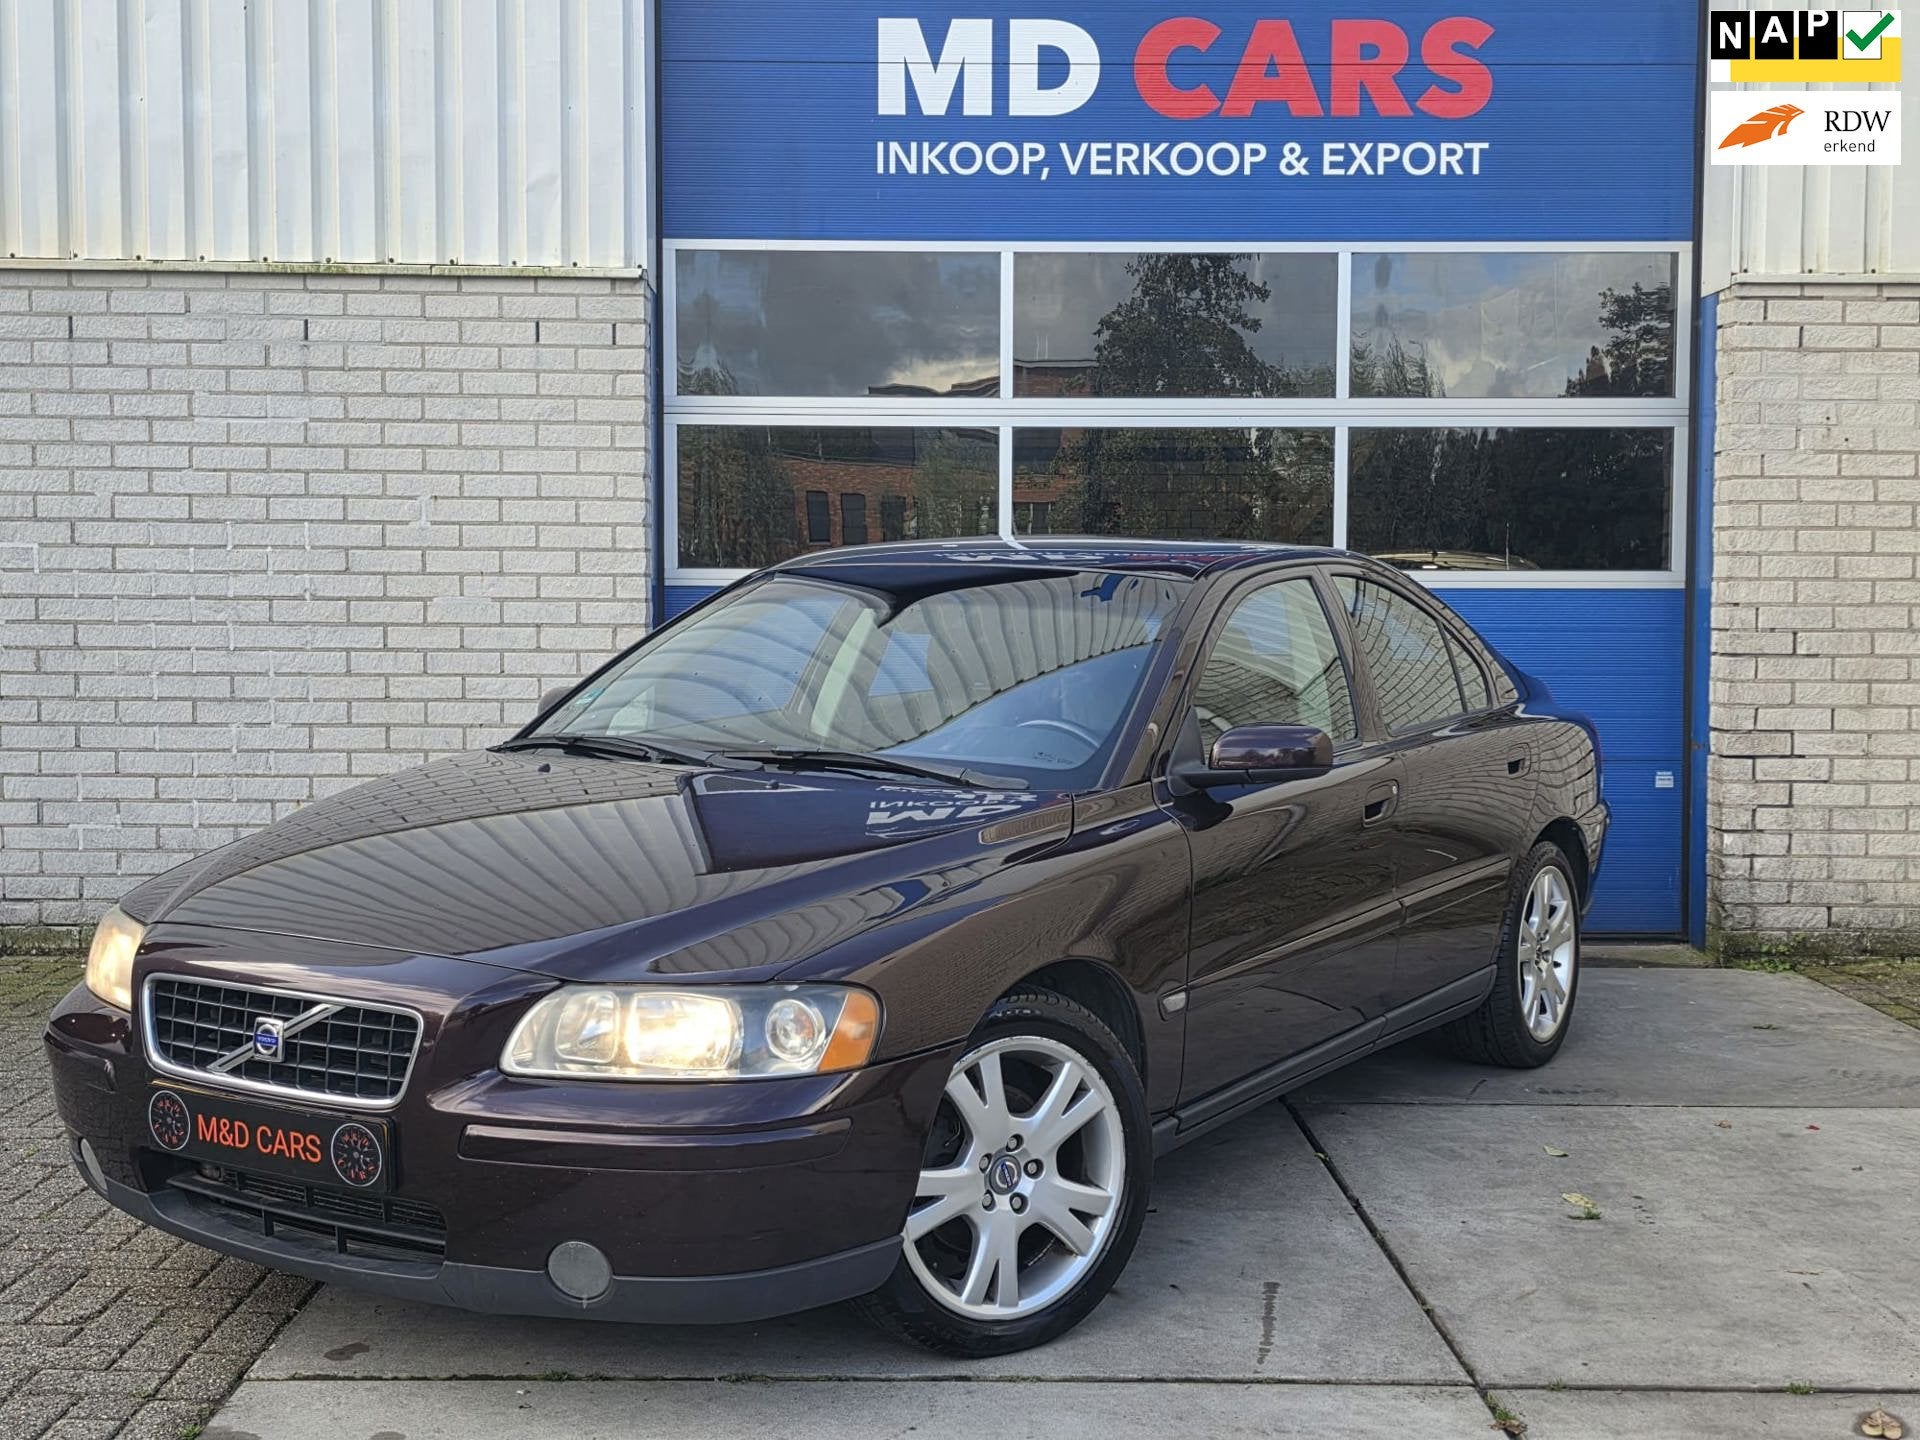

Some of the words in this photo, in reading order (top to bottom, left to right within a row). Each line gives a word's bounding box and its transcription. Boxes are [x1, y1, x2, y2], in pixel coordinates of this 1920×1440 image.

[877, 17, 1101, 117] MD
[1133, 15, 1496, 120] CARS
[876, 140, 1051, 181] INKOOP,
[1058, 141, 1268, 177] VERKOOP
[1278, 140, 1311, 177] &
[1322, 140, 1490, 177] EXPORT
[197, 1113, 250, 1149] M&D
[256, 1125, 322, 1163] CARS
